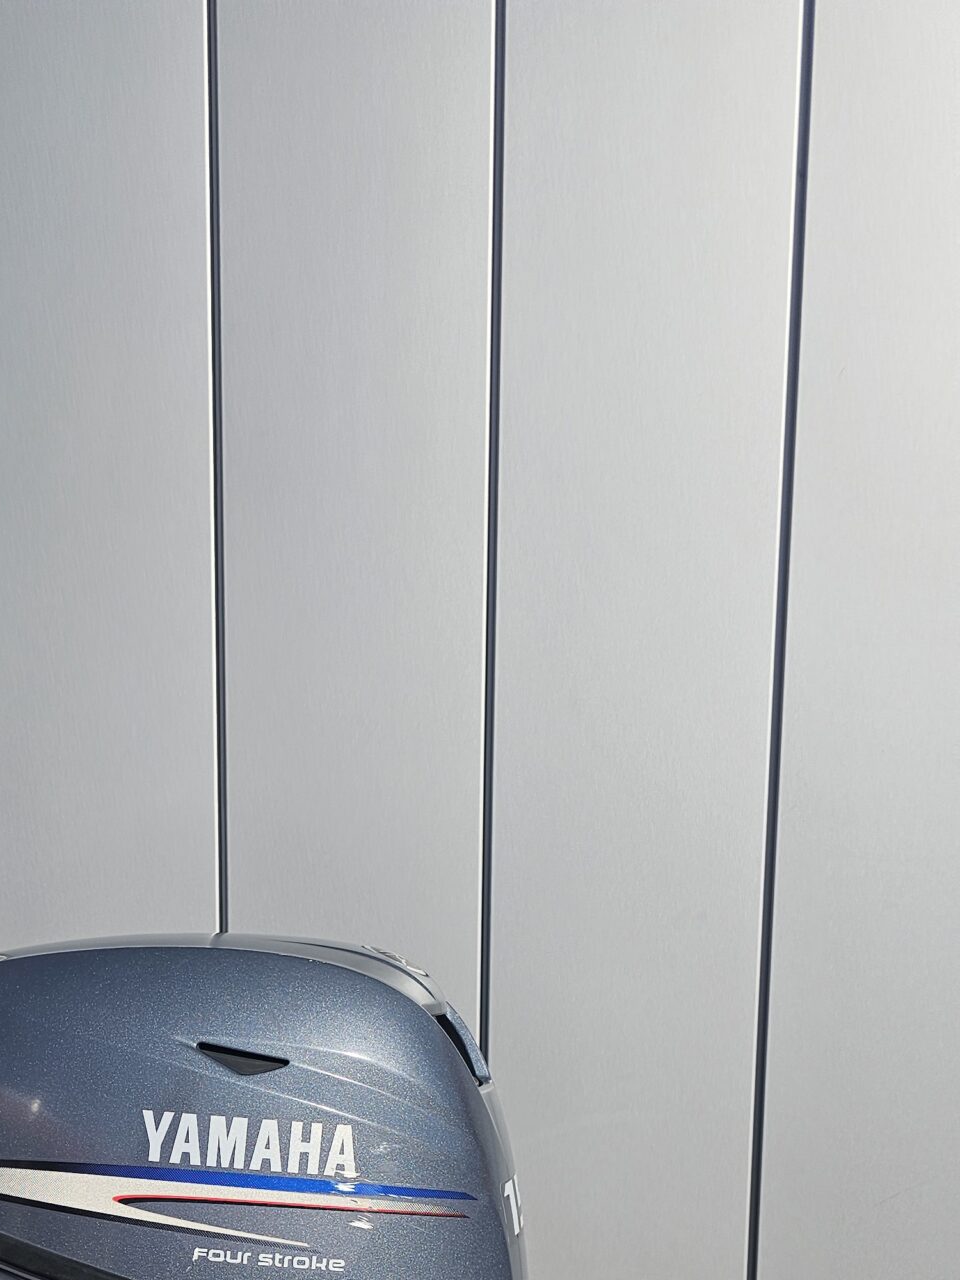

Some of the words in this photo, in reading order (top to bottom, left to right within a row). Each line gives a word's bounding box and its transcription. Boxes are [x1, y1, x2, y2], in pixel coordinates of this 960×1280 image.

[142, 1109, 358, 1178] YAMAHA
[503, 1174, 524, 1236] 1
[257, 1252, 346, 1272] stroke
